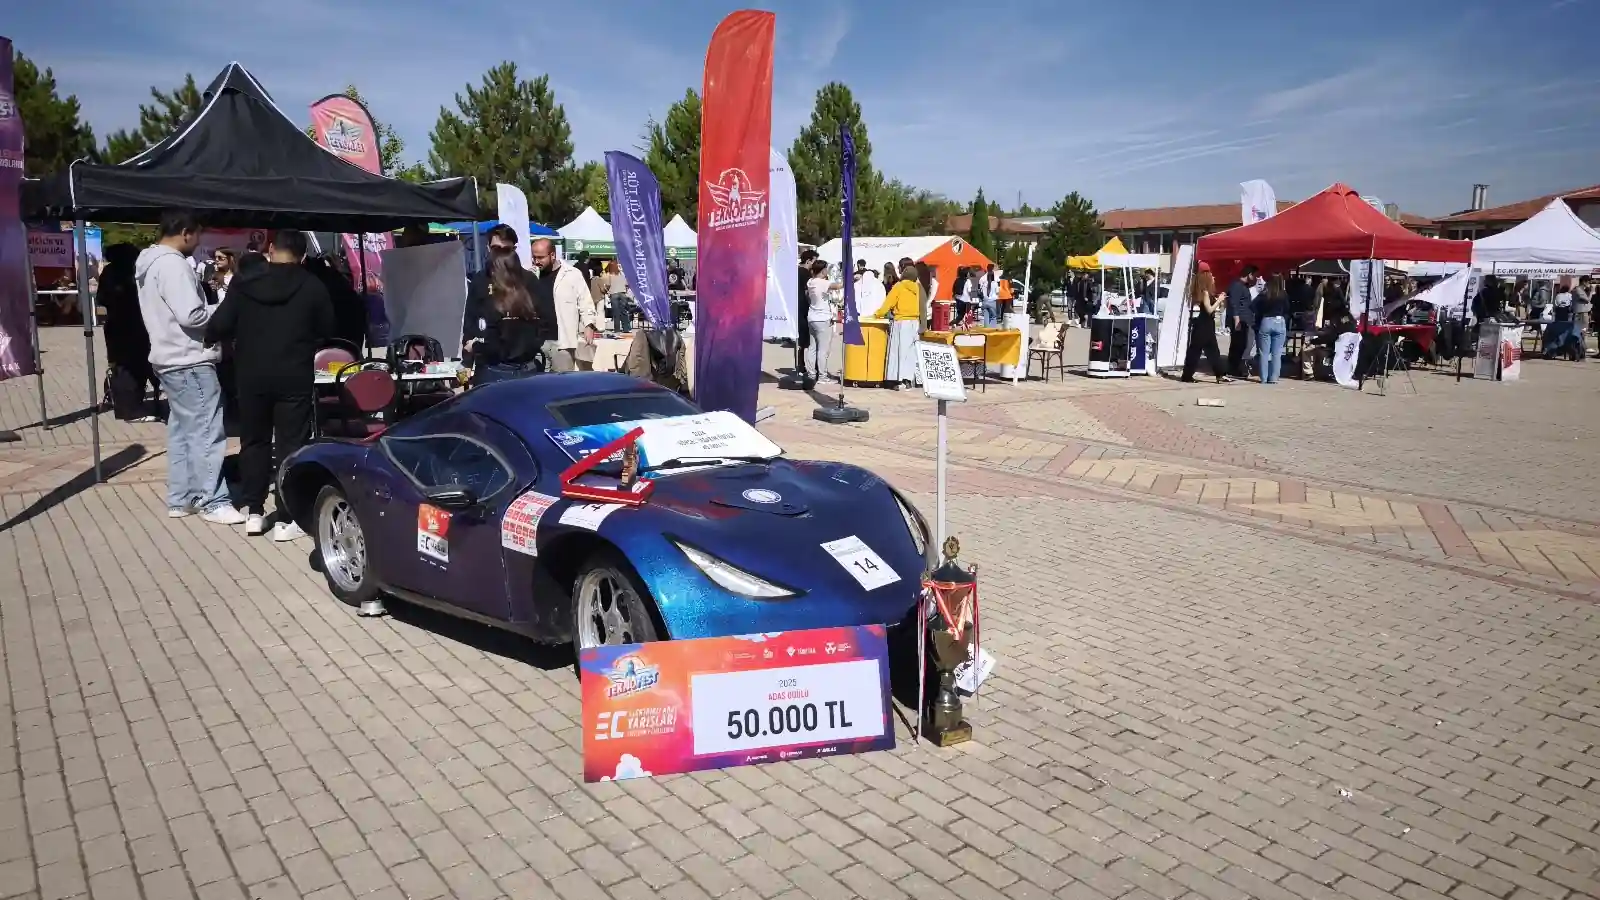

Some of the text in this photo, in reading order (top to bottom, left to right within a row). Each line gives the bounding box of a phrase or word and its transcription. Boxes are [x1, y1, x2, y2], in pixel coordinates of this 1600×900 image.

[707, 201, 767, 228] TEKNOFEST
[853, 557, 880, 574] 14
[778, 678, 797, 688] 2025
[727, 700, 853, 740] 50.000 TL
